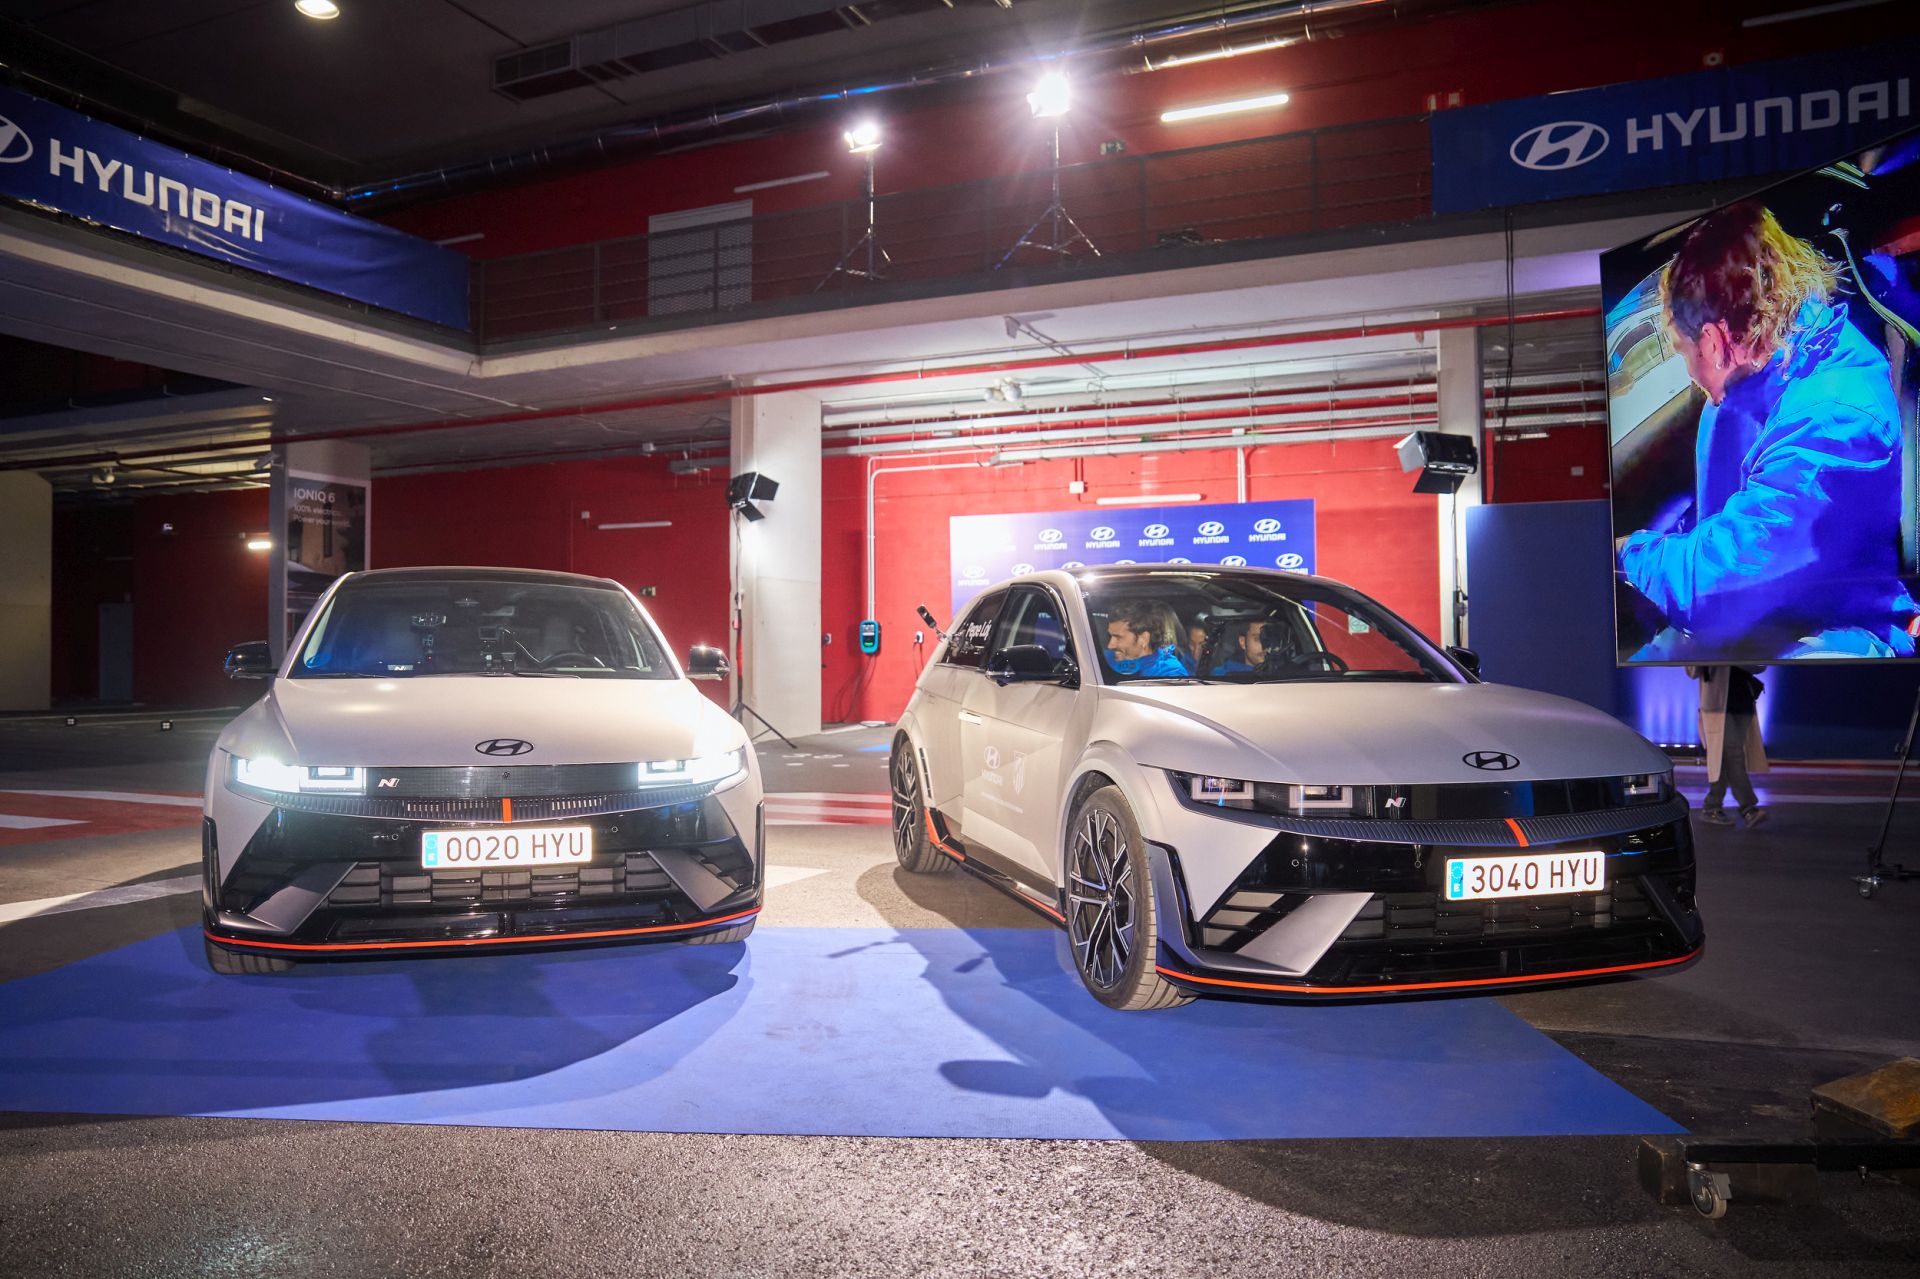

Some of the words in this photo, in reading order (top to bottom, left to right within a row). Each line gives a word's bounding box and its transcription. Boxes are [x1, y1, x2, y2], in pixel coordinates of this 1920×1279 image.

[1626, 78, 1910, 154] HYUNDAI
[50, 138, 265, 242] HYUNDAI
[293, 488, 326, 504] IONIQ
[328, 492, 336, 503] 6
[1138, 538, 1174, 547] HYUNDAI
[1193, 535, 1229, 545] HYUNDAI
[1248, 533, 1287, 542] HYUNDAI
[1033, 542, 1068, 551] HYUNDAI
[1085, 540, 1120, 549] HYUNDAI
[446, 835, 520, 862] 0020
[531, 831, 584, 859] HYU
[1471, 861, 1540, 894] 3040
[1550, 857, 1598, 889] HYU
